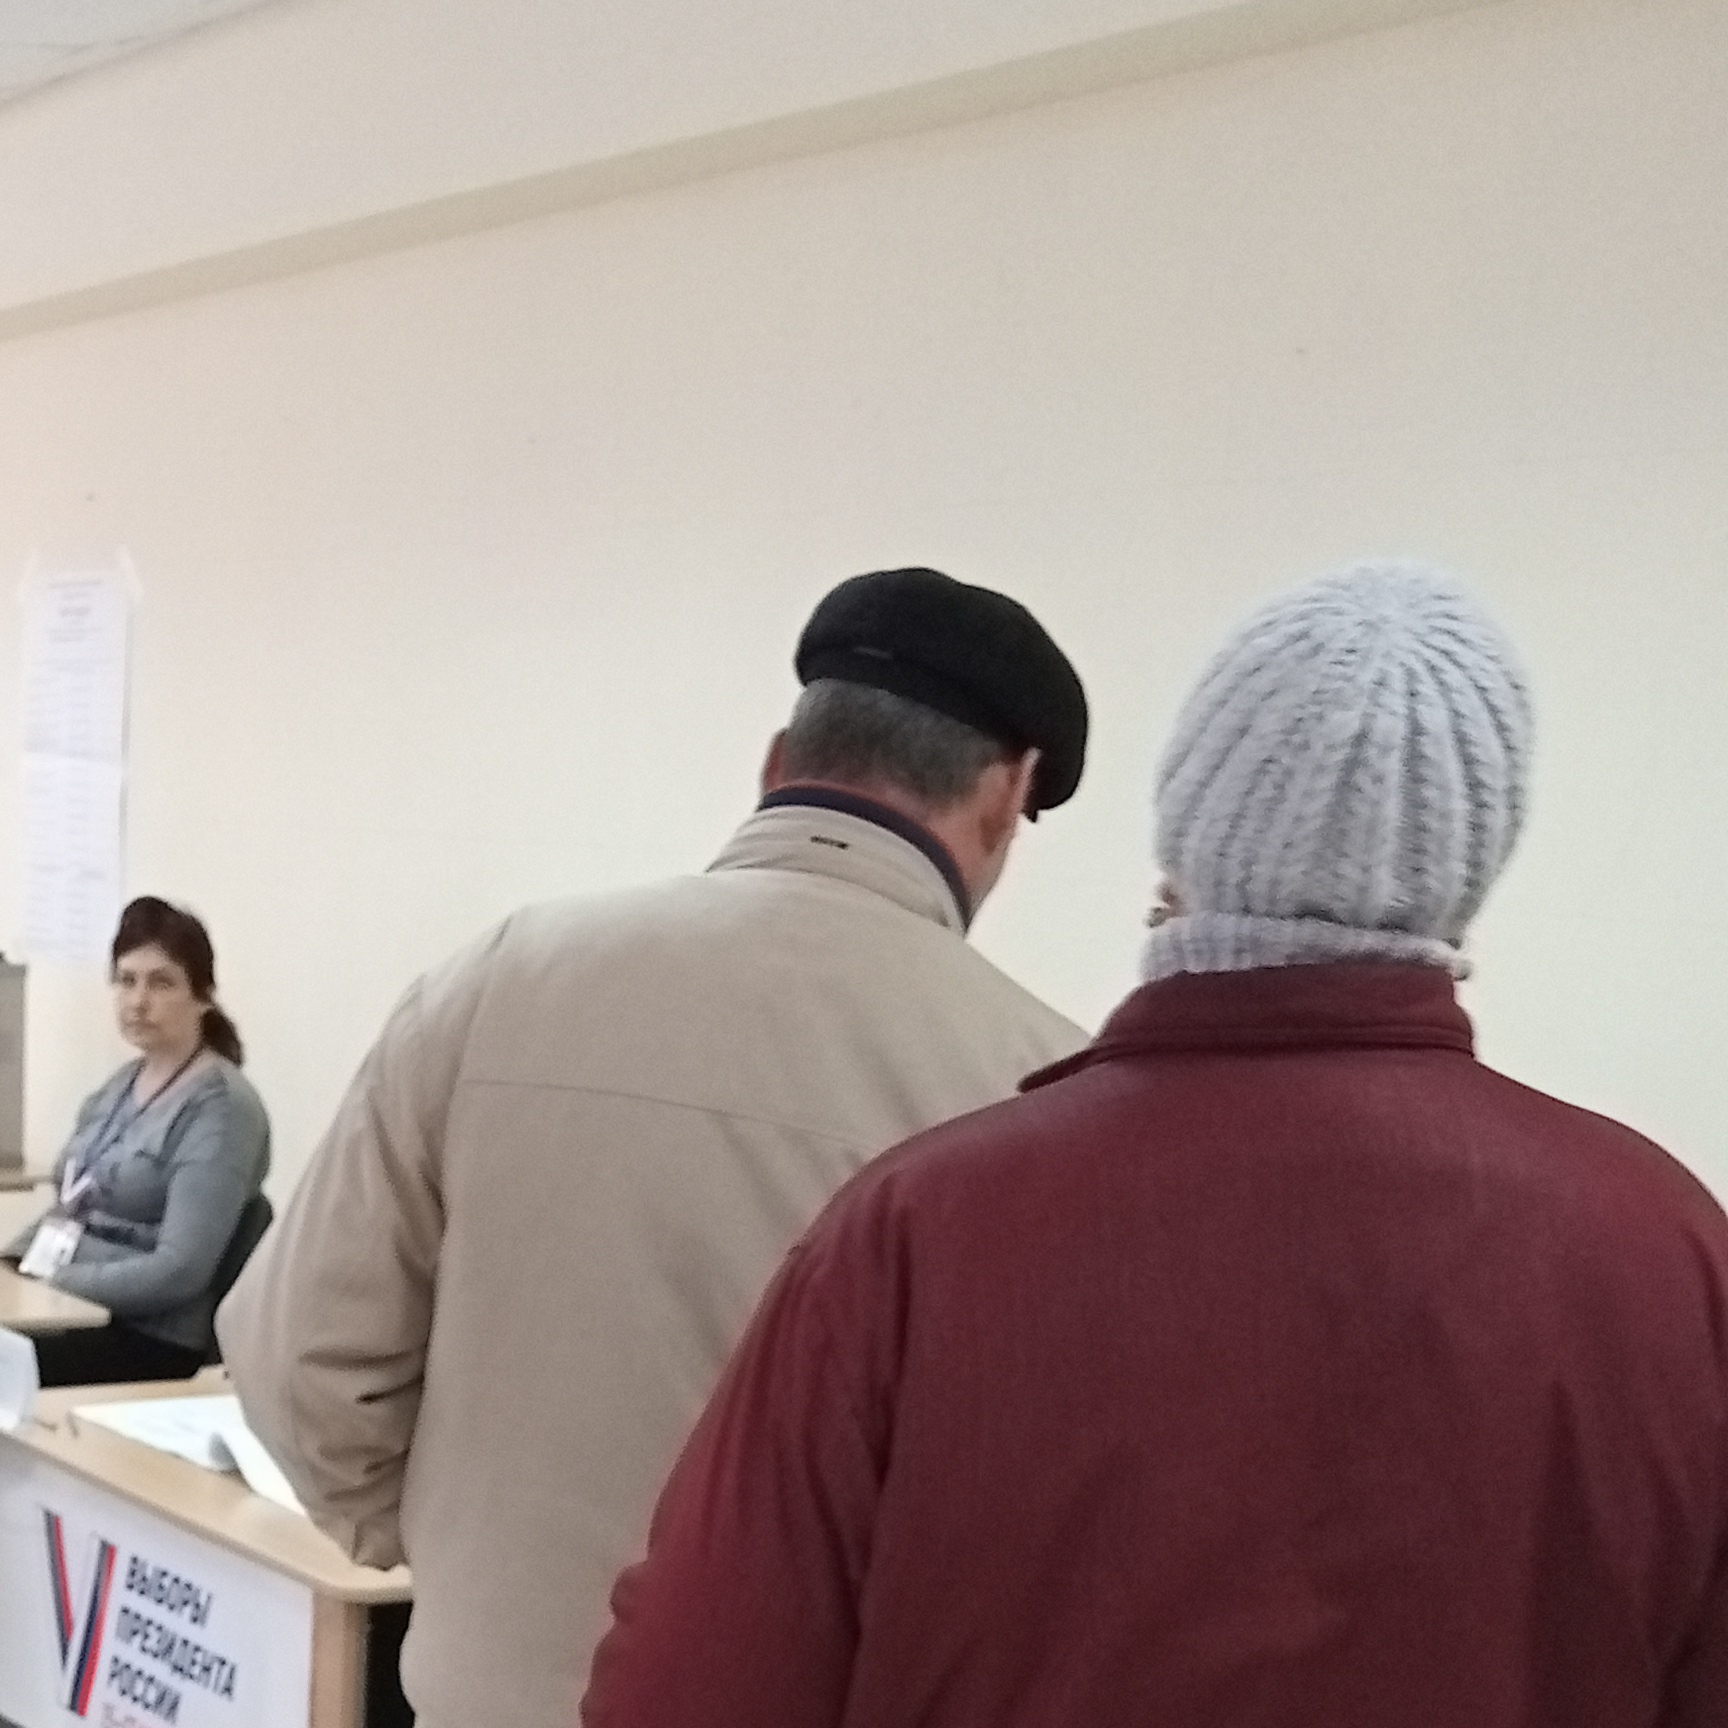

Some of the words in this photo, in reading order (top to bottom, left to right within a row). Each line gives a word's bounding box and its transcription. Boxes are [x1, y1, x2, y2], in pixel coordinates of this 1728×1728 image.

[125, 1554, 214, 1627] ВЫБОРЫ
[114, 1605, 237, 1701] ПРЕЗИДЕНТА
[107, 1655, 182, 1725] РОССИИ
